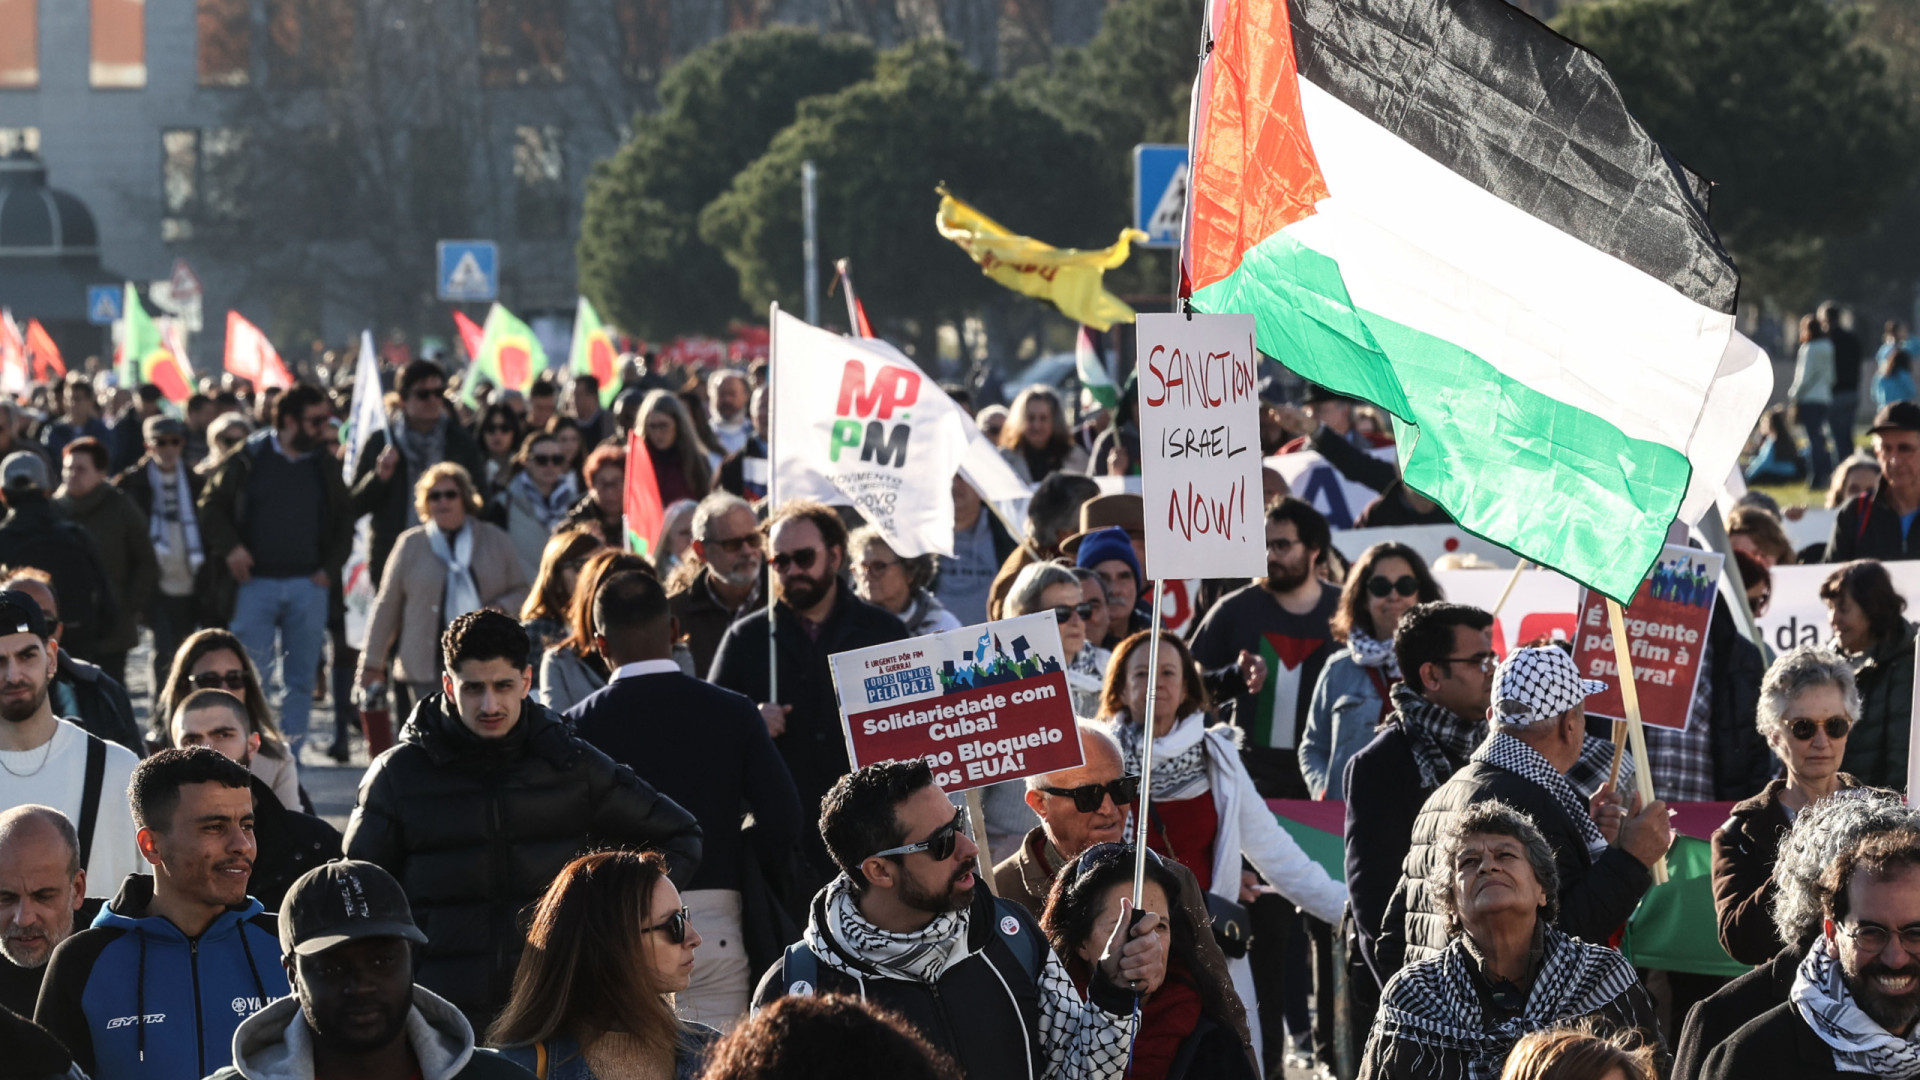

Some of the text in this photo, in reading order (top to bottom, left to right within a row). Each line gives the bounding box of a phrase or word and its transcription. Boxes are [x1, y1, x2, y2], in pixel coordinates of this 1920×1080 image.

[1147, 332, 1254, 409] SANCTION
[1162, 425, 1247, 459] ISRAEL
[1168, 474, 1246, 543] NOW!
[1586, 604, 1603, 626] É
[871, 656, 897, 667] URGENTE
[913, 650, 924, 659] FIM
[1584, 633, 1690, 665] pô fim à
[886, 661, 911, 672] GUERRA!
[1589, 658, 1676, 687] gurra!
[868, 678, 934, 701] PELA PAZ!
[863, 685, 1056, 735] Solidariedade com
[929, 712, 998, 741] Cuba!
[958, 727, 1063, 762] Bloqueio
[966, 753, 1026, 780] EUA!
